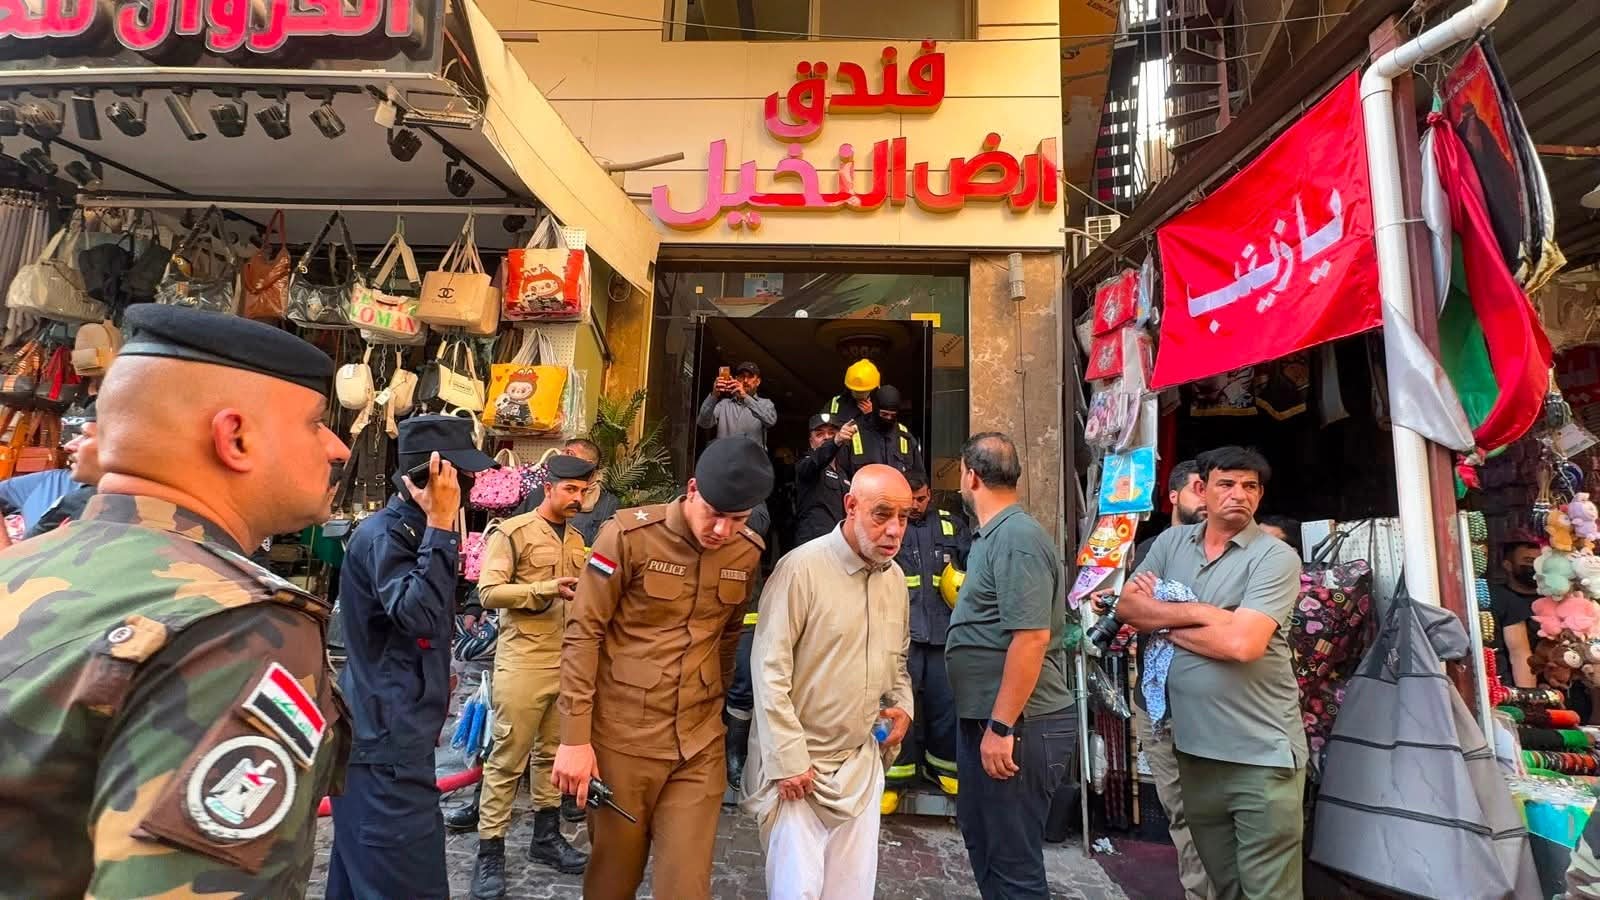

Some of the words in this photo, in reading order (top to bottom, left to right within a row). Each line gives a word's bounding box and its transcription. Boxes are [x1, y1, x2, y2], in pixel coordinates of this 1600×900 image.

[764, 40, 946, 142] فندق
[652, 138, 908, 231] النخيل
[913, 132, 1058, 213] ارض
[1187, 219, 1294, 334] زينب
[1294, 188, 1344, 284] يا
[649, 560, 687, 576] POLICE
